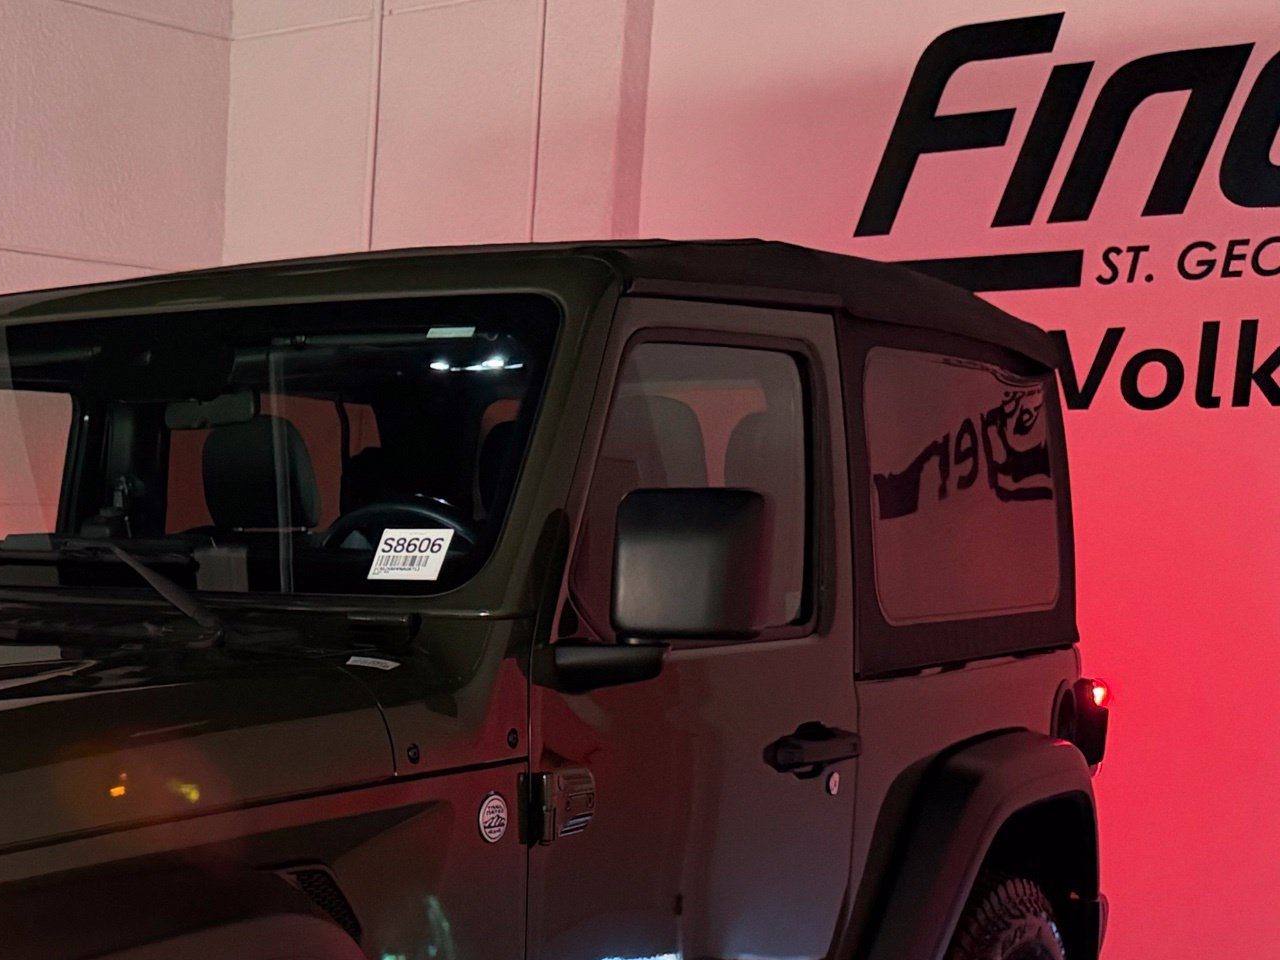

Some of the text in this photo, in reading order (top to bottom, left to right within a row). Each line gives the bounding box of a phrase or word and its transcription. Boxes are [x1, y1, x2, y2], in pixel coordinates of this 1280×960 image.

[1095, 245, 1154, 285] ST.
[1047, 319, 1280, 411] Volk
[381, 537, 445, 554] S8606
